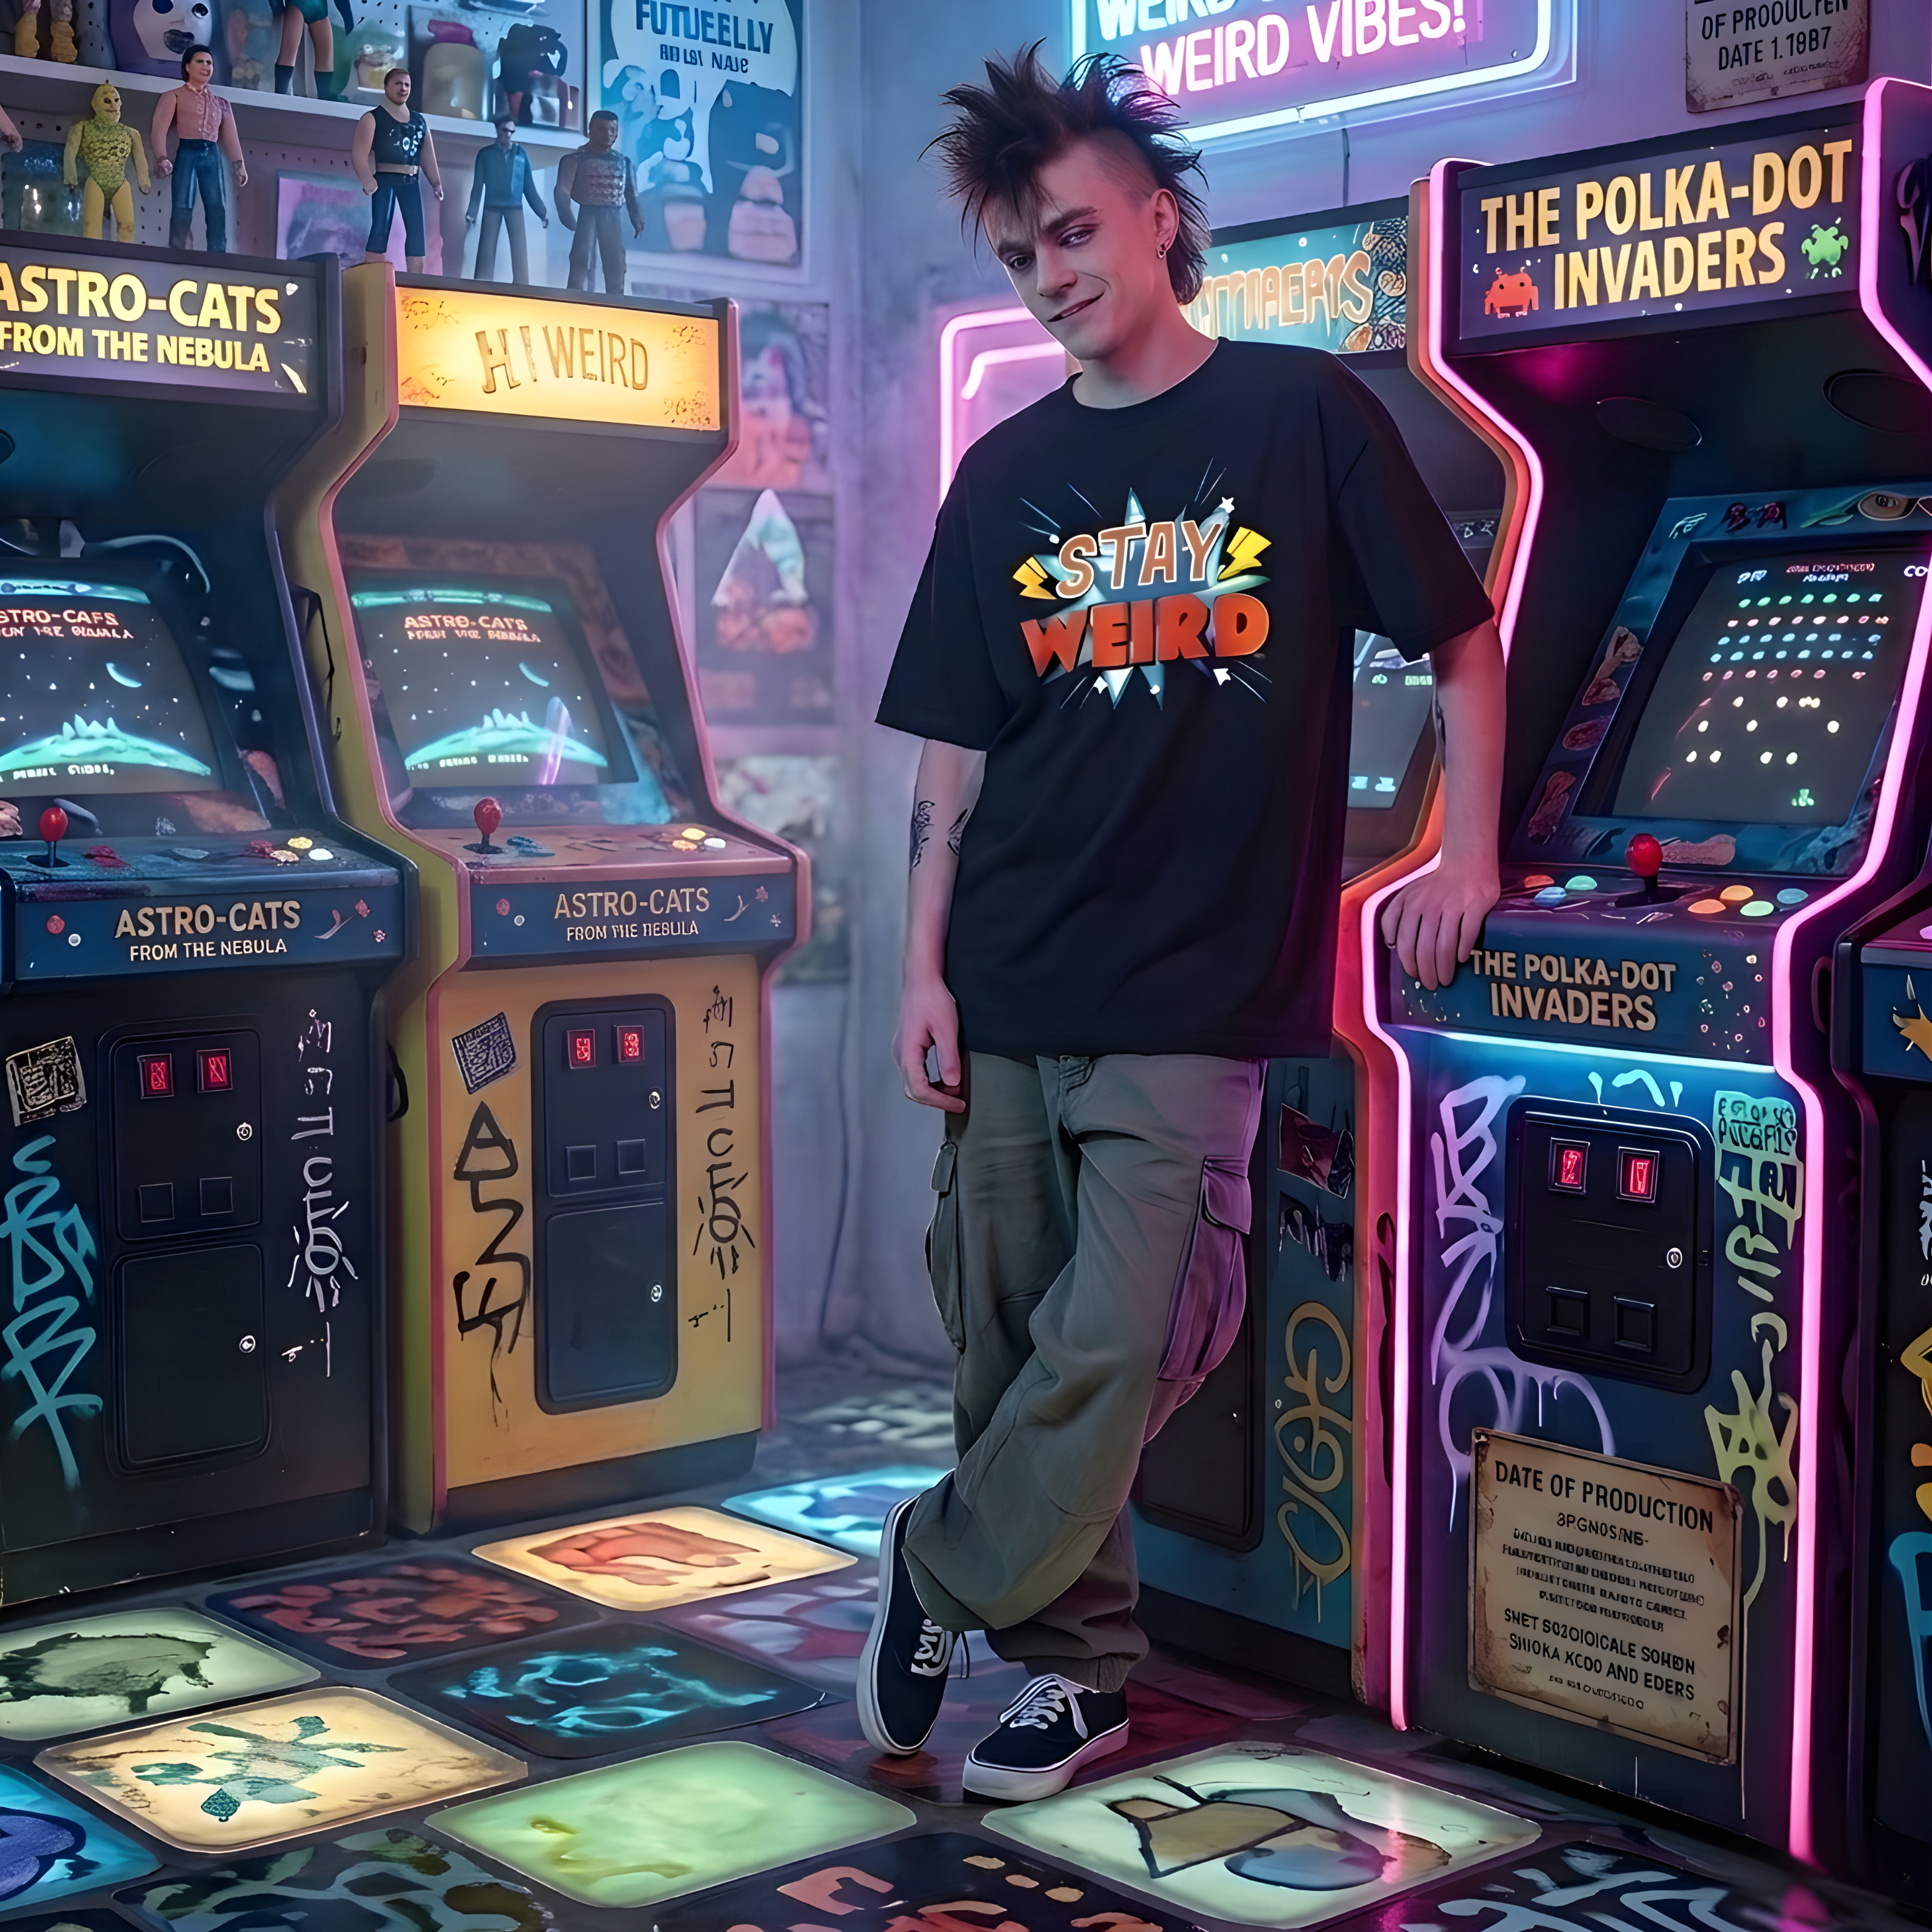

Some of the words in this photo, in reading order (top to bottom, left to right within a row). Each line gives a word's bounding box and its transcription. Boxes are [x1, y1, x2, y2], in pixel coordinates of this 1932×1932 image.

[1141, 13, 1290, 95] WEIRD
[1307, 0, 1467, 62] VIBES!
[1702, 13, 1727, 39] OF
[1719, 40, 1763, 70] DATE
[1481, 187, 1560, 254] THE
[1576, 139, 1852, 241] POLKA-DOT
[1554, 222, 1785, 310] INVADERS
[0, 321, 84, 357] FROM
[92, 329, 148, 362] THE
[157, 335, 270, 372] NEBULA
[542, 325, 648, 390] WEIRD
[1056, 520, 1222, 599] STAY
[1021, 593, 1270, 678] WEIRD
[115, 900, 301, 938] ASTRO-CATS
[554, 887, 710, 919] ASTRO-CATS
[130, 944, 178, 961] FROM
[183, 941, 216, 958] THE
[221, 938, 287, 956] NEBULA
[1470, 950, 1516, 978] THE
[1524, 953, 1676, 992] POLKA-DOT
[1491, 982, 1656, 1031] INVADERS
[1496, 1461, 1543, 1492] DATE
[1550, 1474, 1575, 1498] OF
[1582, 1481, 1713, 1533] PRODUCTION
[1606, 1662, 1638, 1684] AND
